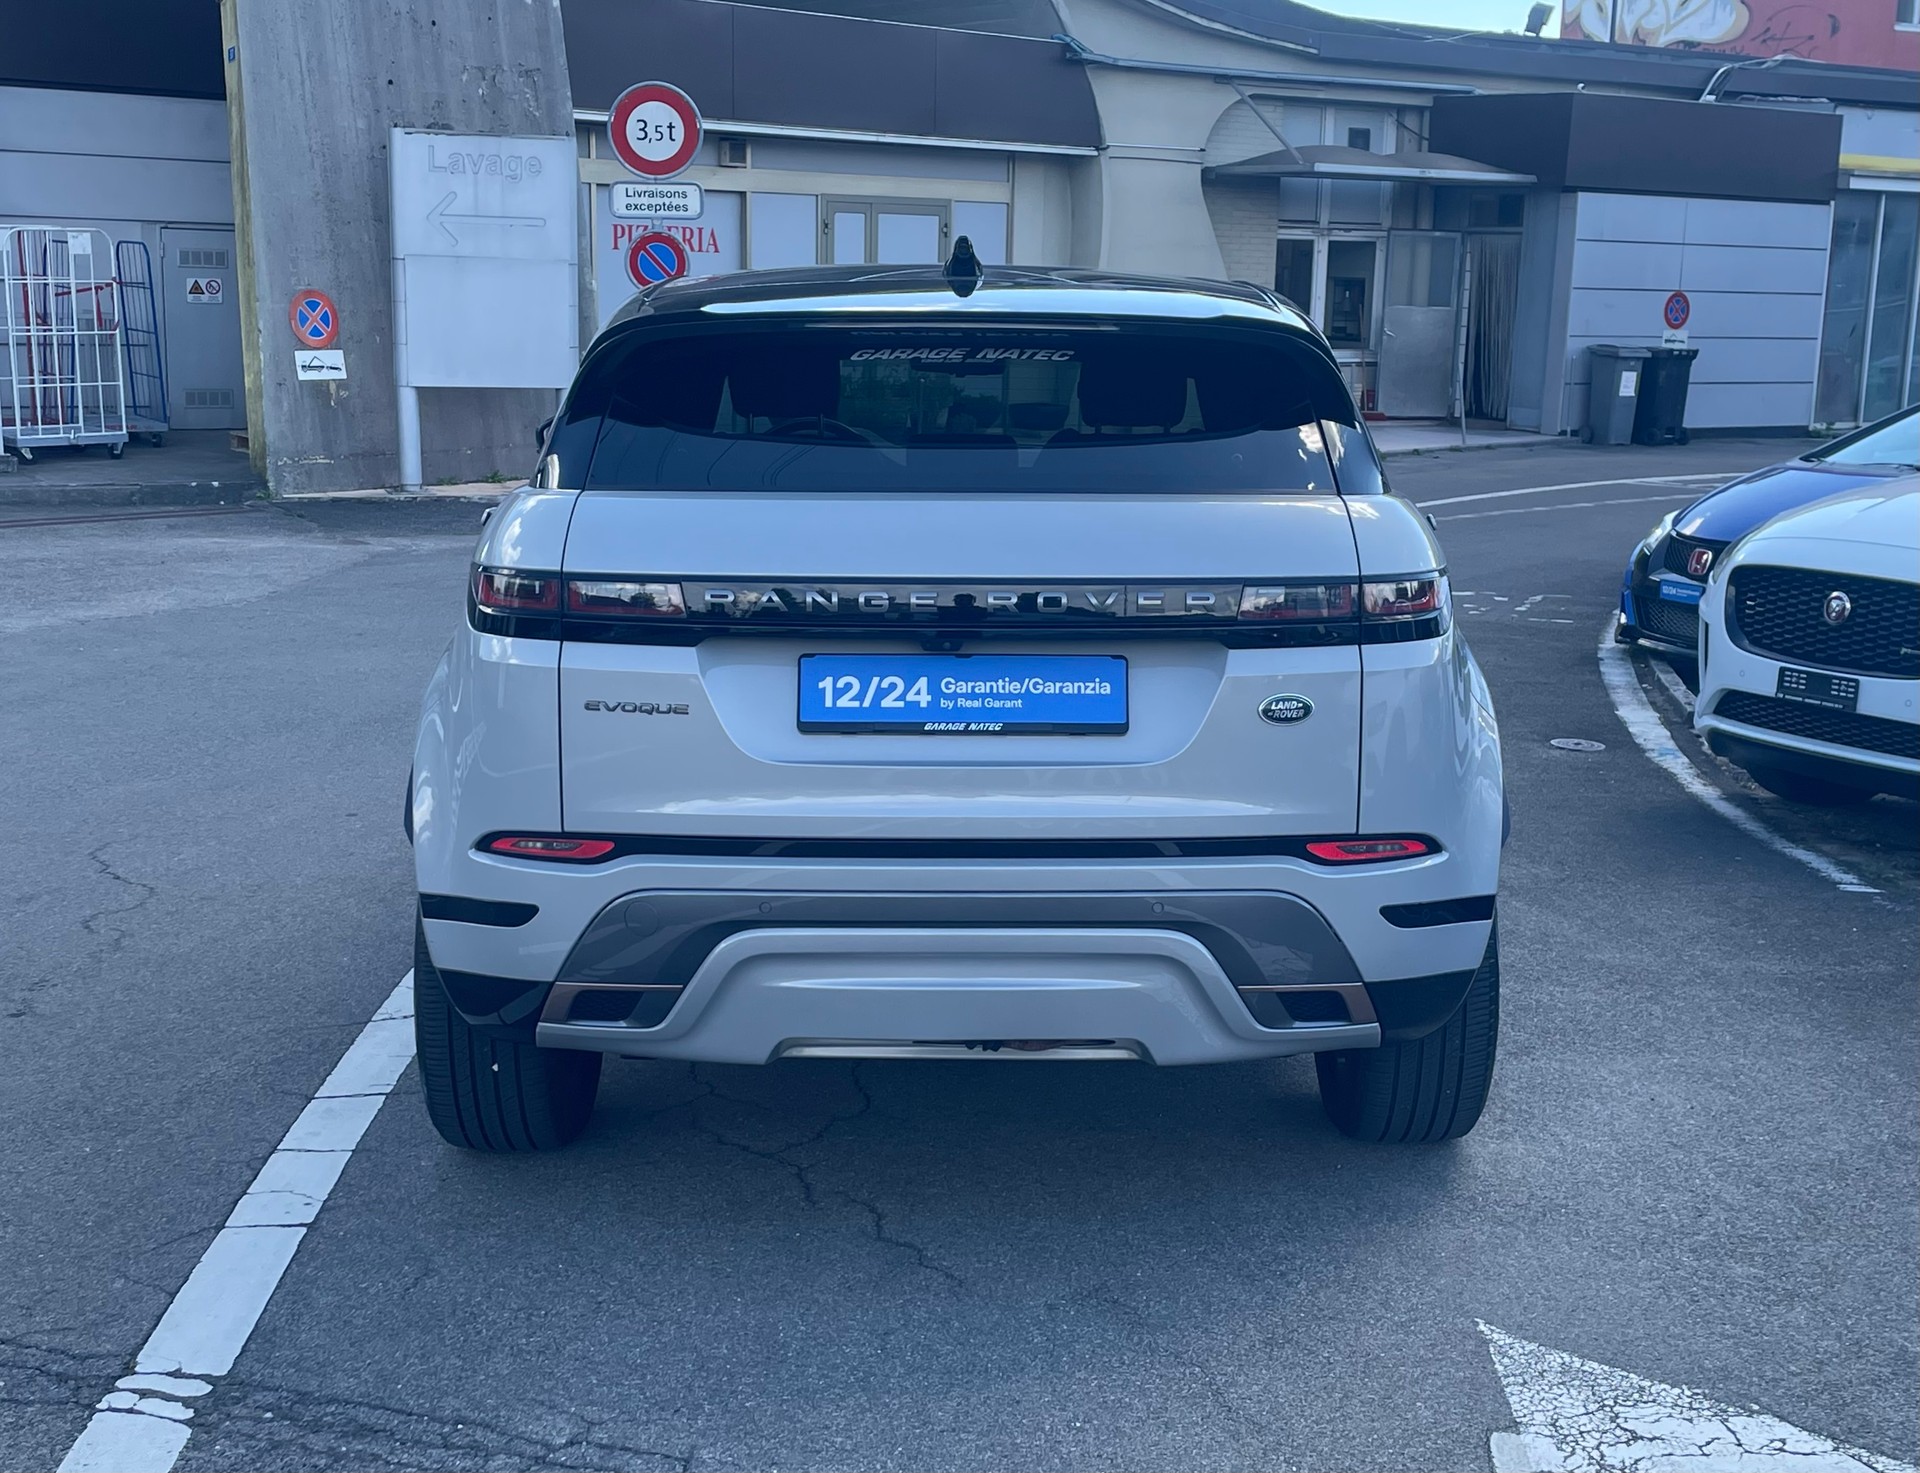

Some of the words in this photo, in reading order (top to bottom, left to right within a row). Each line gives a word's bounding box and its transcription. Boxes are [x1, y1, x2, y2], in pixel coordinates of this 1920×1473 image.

[428, 144, 542, 183] Lavage
[625, 187, 688, 199] Livraisons
[625, 201, 689, 214] exceptées
[612, 223, 720, 253] PIRIA
[850, 348, 971, 361] GARAGE
[975, 349, 1075, 361] NATEC
[704, 589, 938, 613] RANGE
[987, 591, 1216, 613] ROVER
[818, 675, 932, 708] 12/24
[940, 677, 1111, 695] Garantie/Garanzia
[584, 700, 690, 715] EVOQUE
[940, 698, 954, 710] by
[957, 698, 982, 708] Real
[984, 698, 1023, 708] Garant
[1271, 701, 1298, 710] LAND
[1273, 709, 1305, 718] ROVER
[923, 723, 967, 731] GARAGE
[967, 723, 1004, 731] NATEC
